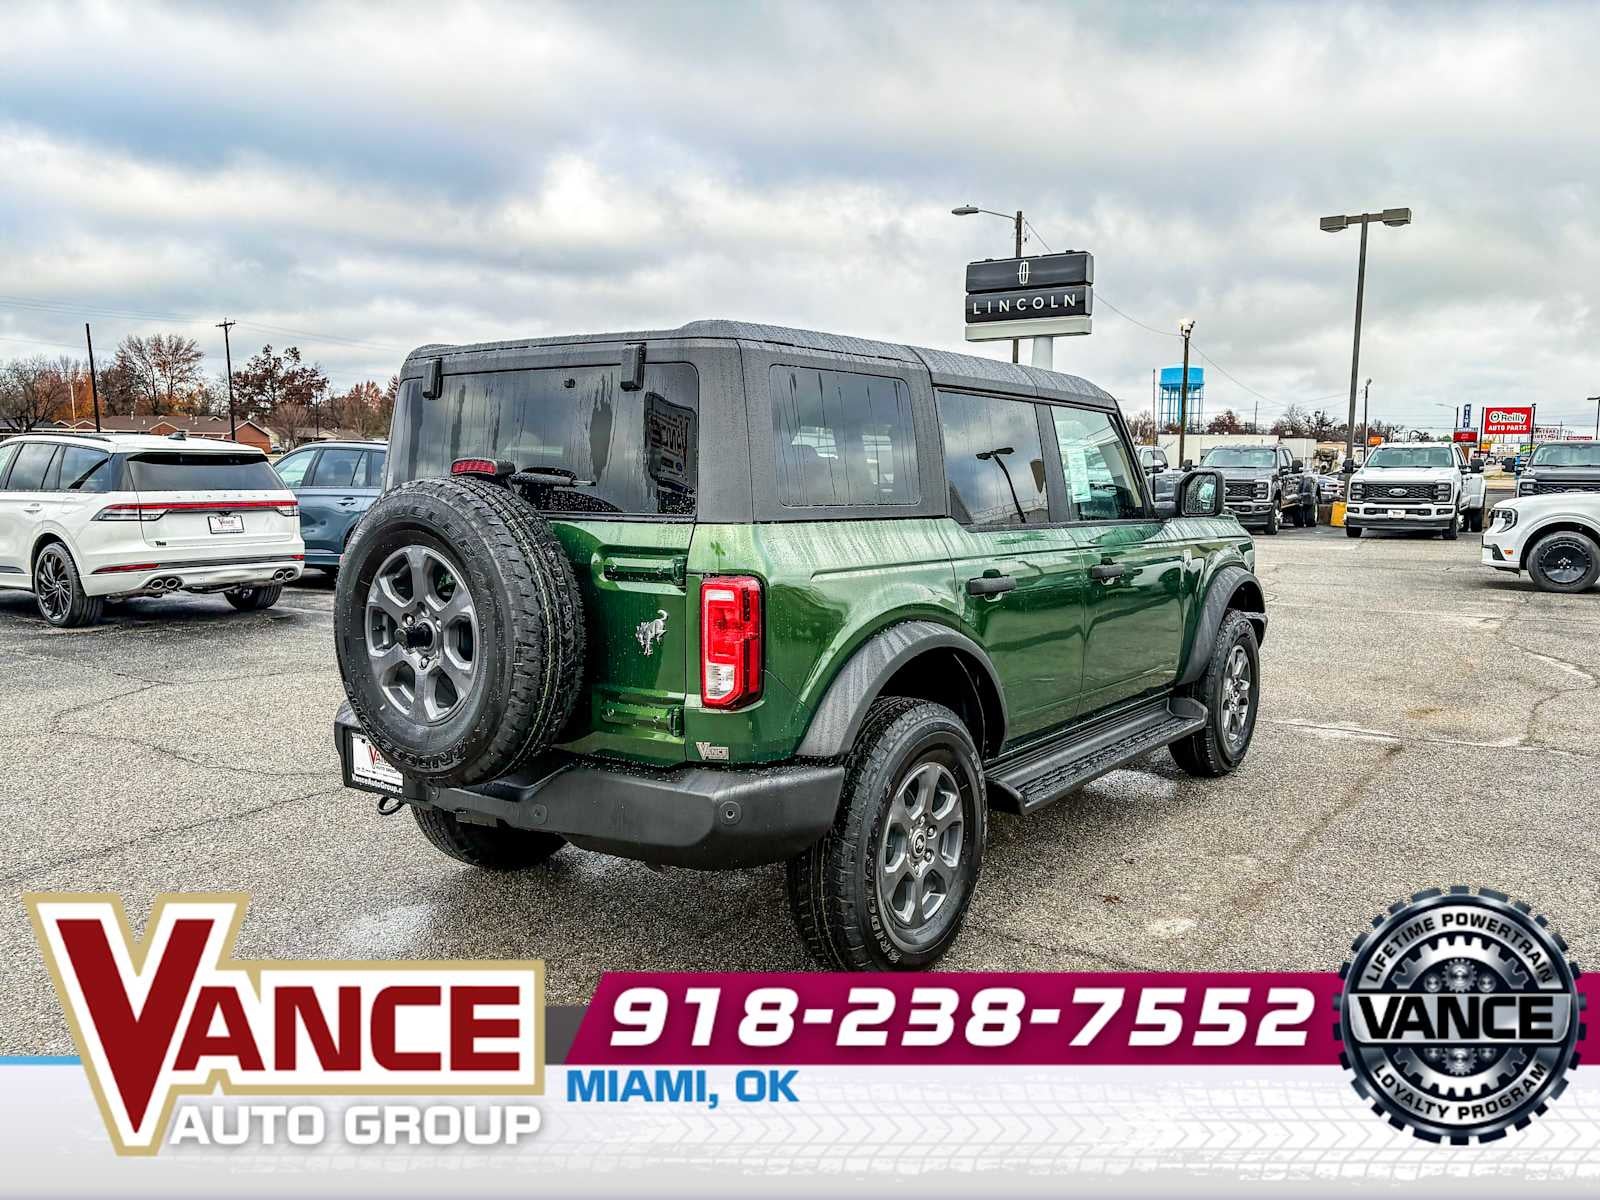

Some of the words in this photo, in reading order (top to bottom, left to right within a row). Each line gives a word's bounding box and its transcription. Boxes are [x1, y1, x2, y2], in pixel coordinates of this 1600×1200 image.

[973, 293, 1076, 315] LINCOLN
[1490, 411, 1526, 423] O'Reilly
[696, 742, 728, 760] VANCE
